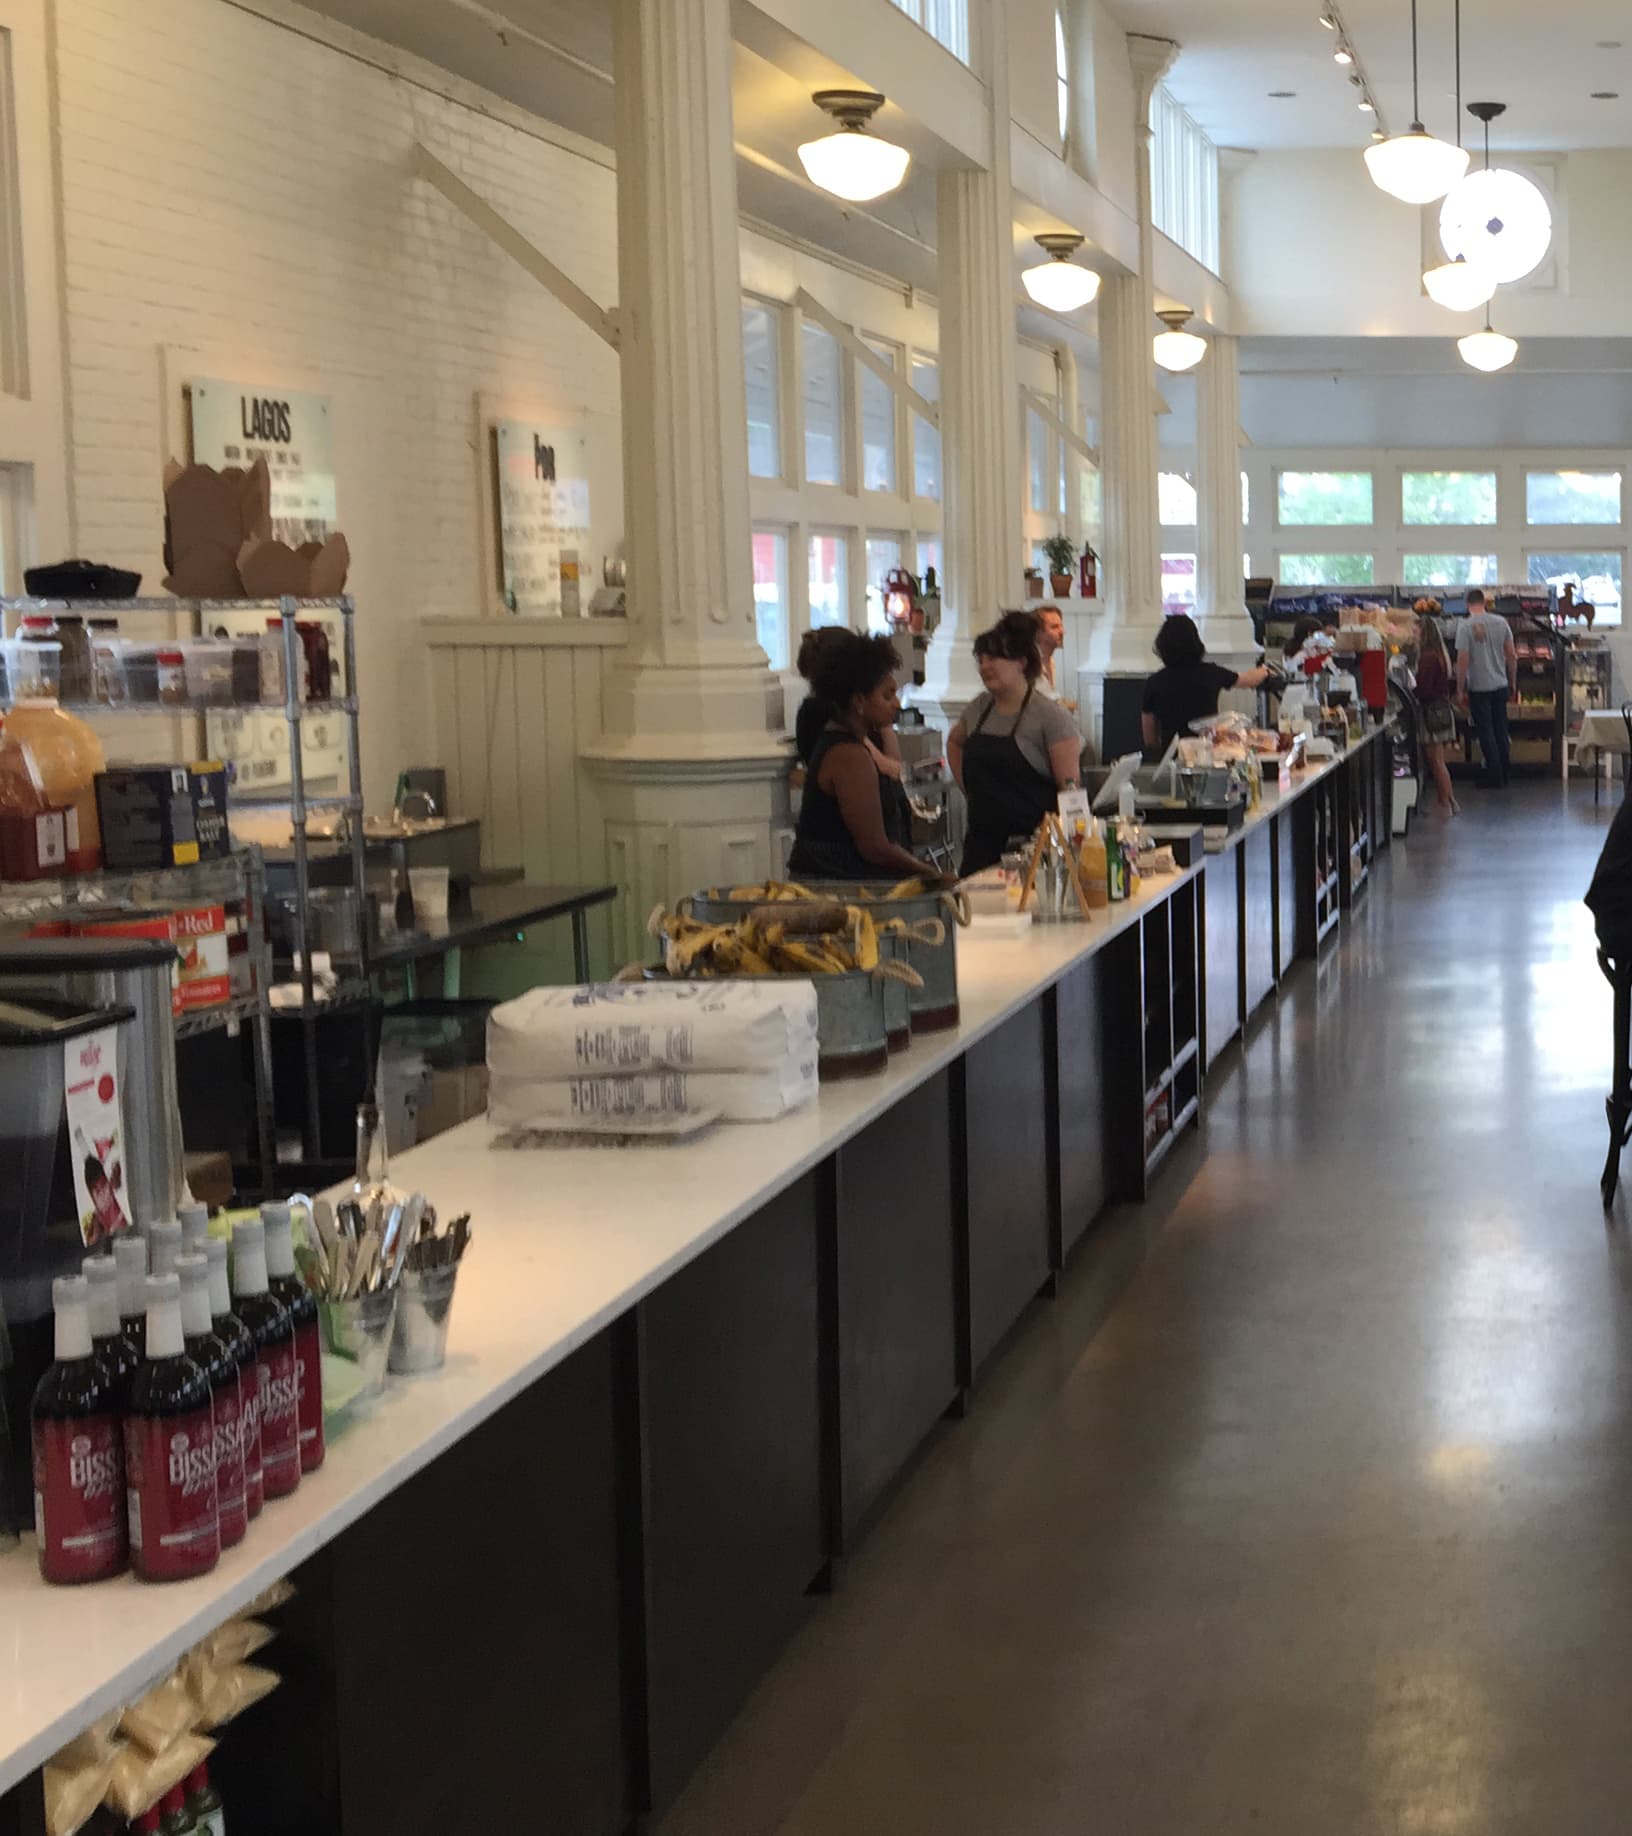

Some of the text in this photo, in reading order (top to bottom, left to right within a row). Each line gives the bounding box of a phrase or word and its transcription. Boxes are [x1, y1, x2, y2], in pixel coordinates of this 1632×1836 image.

[241, 396, 291, 444] LAGOS
[70, 1450, 116, 1488] BISS
[169, 1444, 216, 1486] BISS
